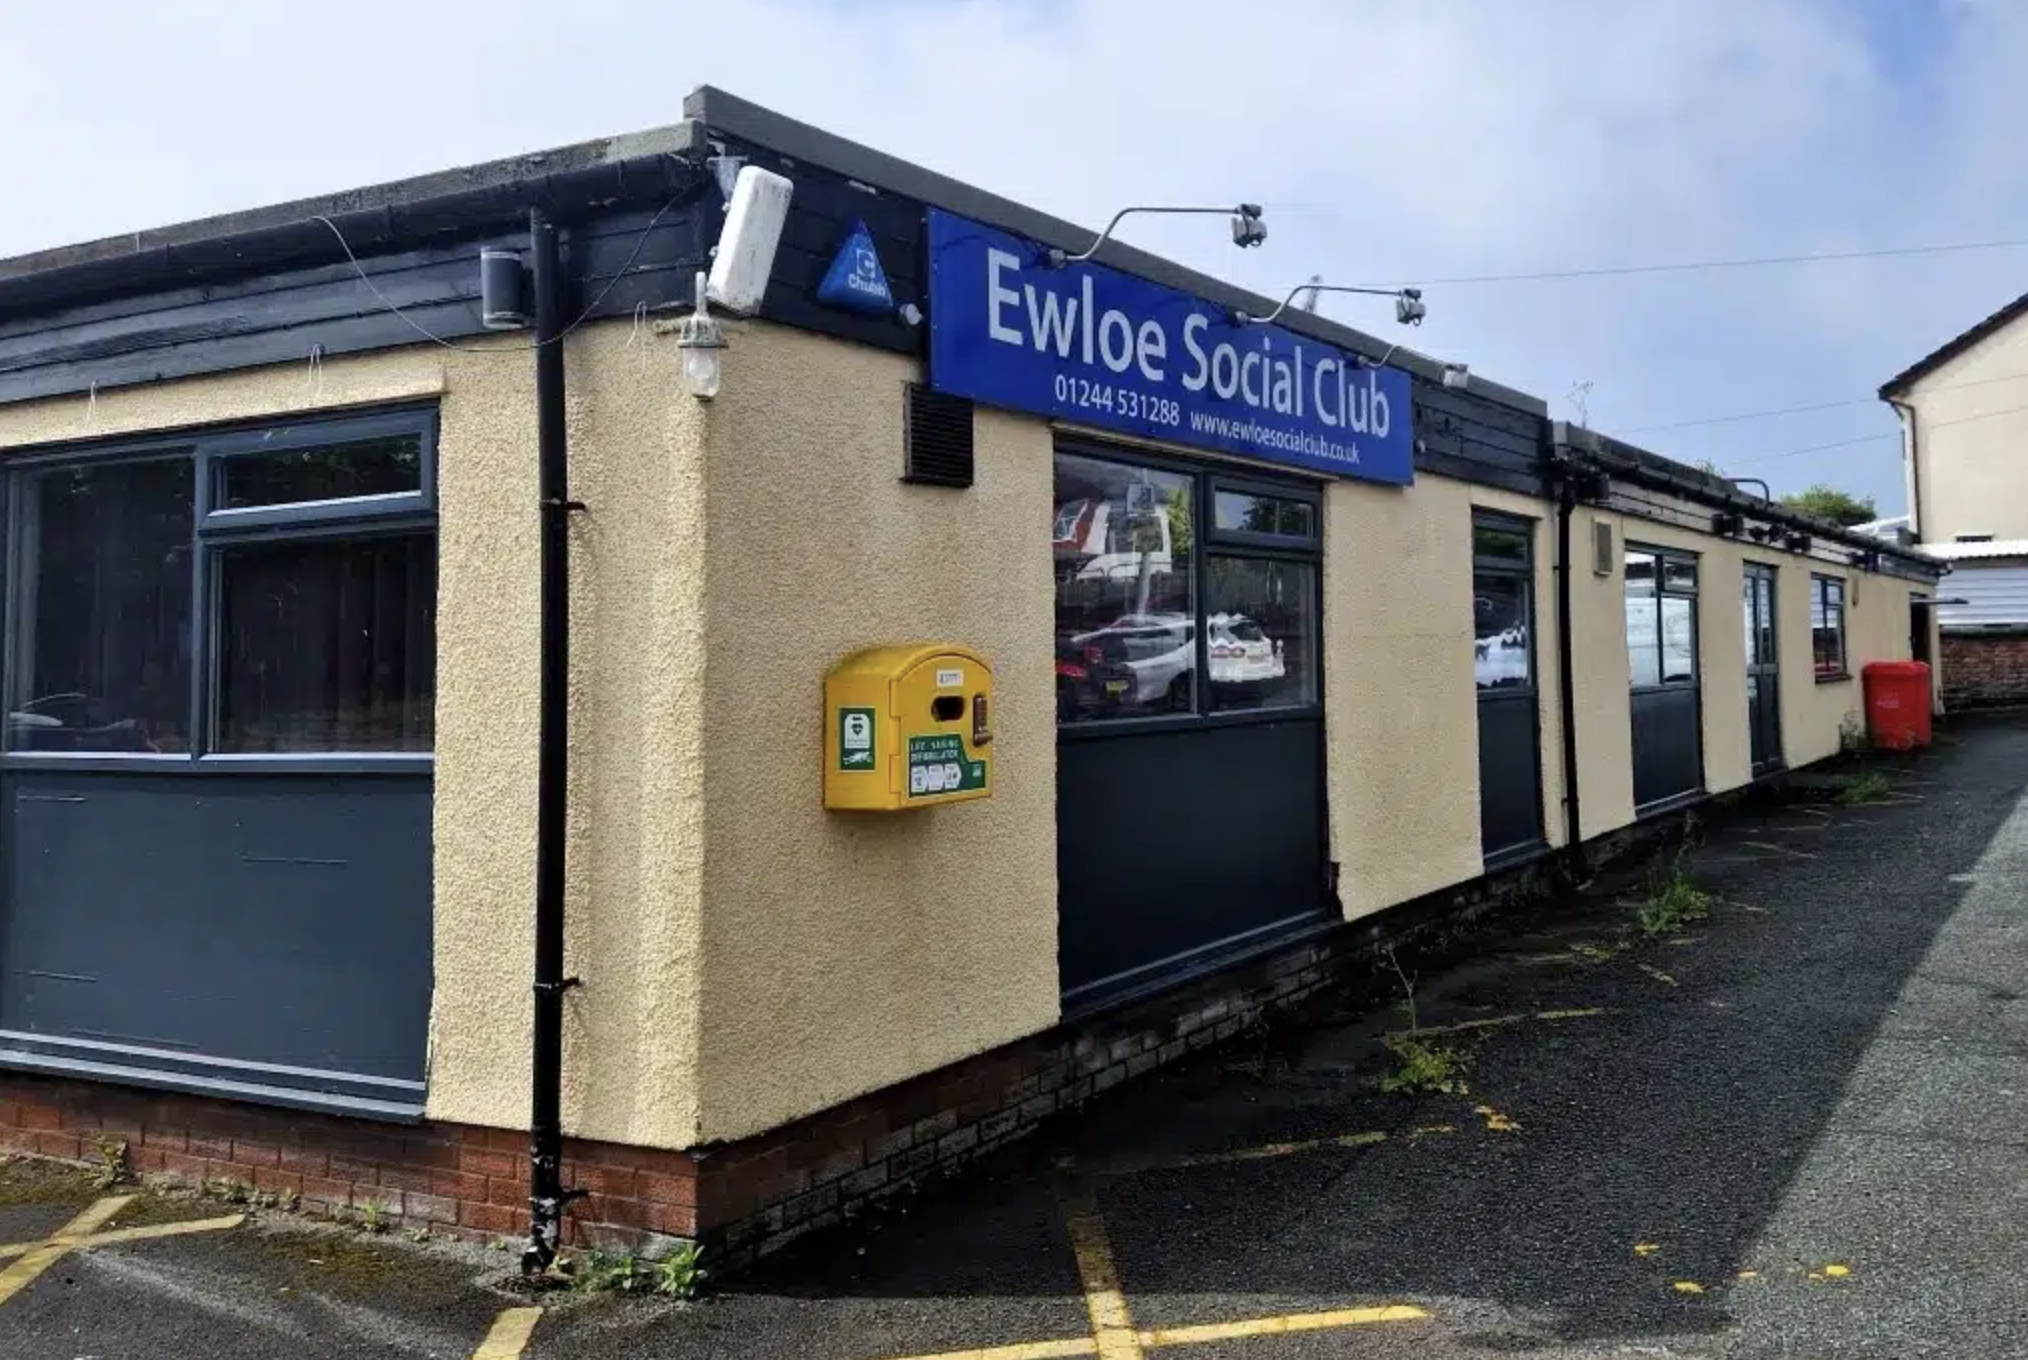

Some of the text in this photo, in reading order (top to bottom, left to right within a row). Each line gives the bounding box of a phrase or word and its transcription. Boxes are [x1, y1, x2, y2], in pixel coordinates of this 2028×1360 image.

[848, 273, 887, 297] Chubb
[988, 247, 1391, 438] Ewloe Social Club
[1055, 374, 1361, 464] 01244 531288 www.ewloesocialclub.co.uk
